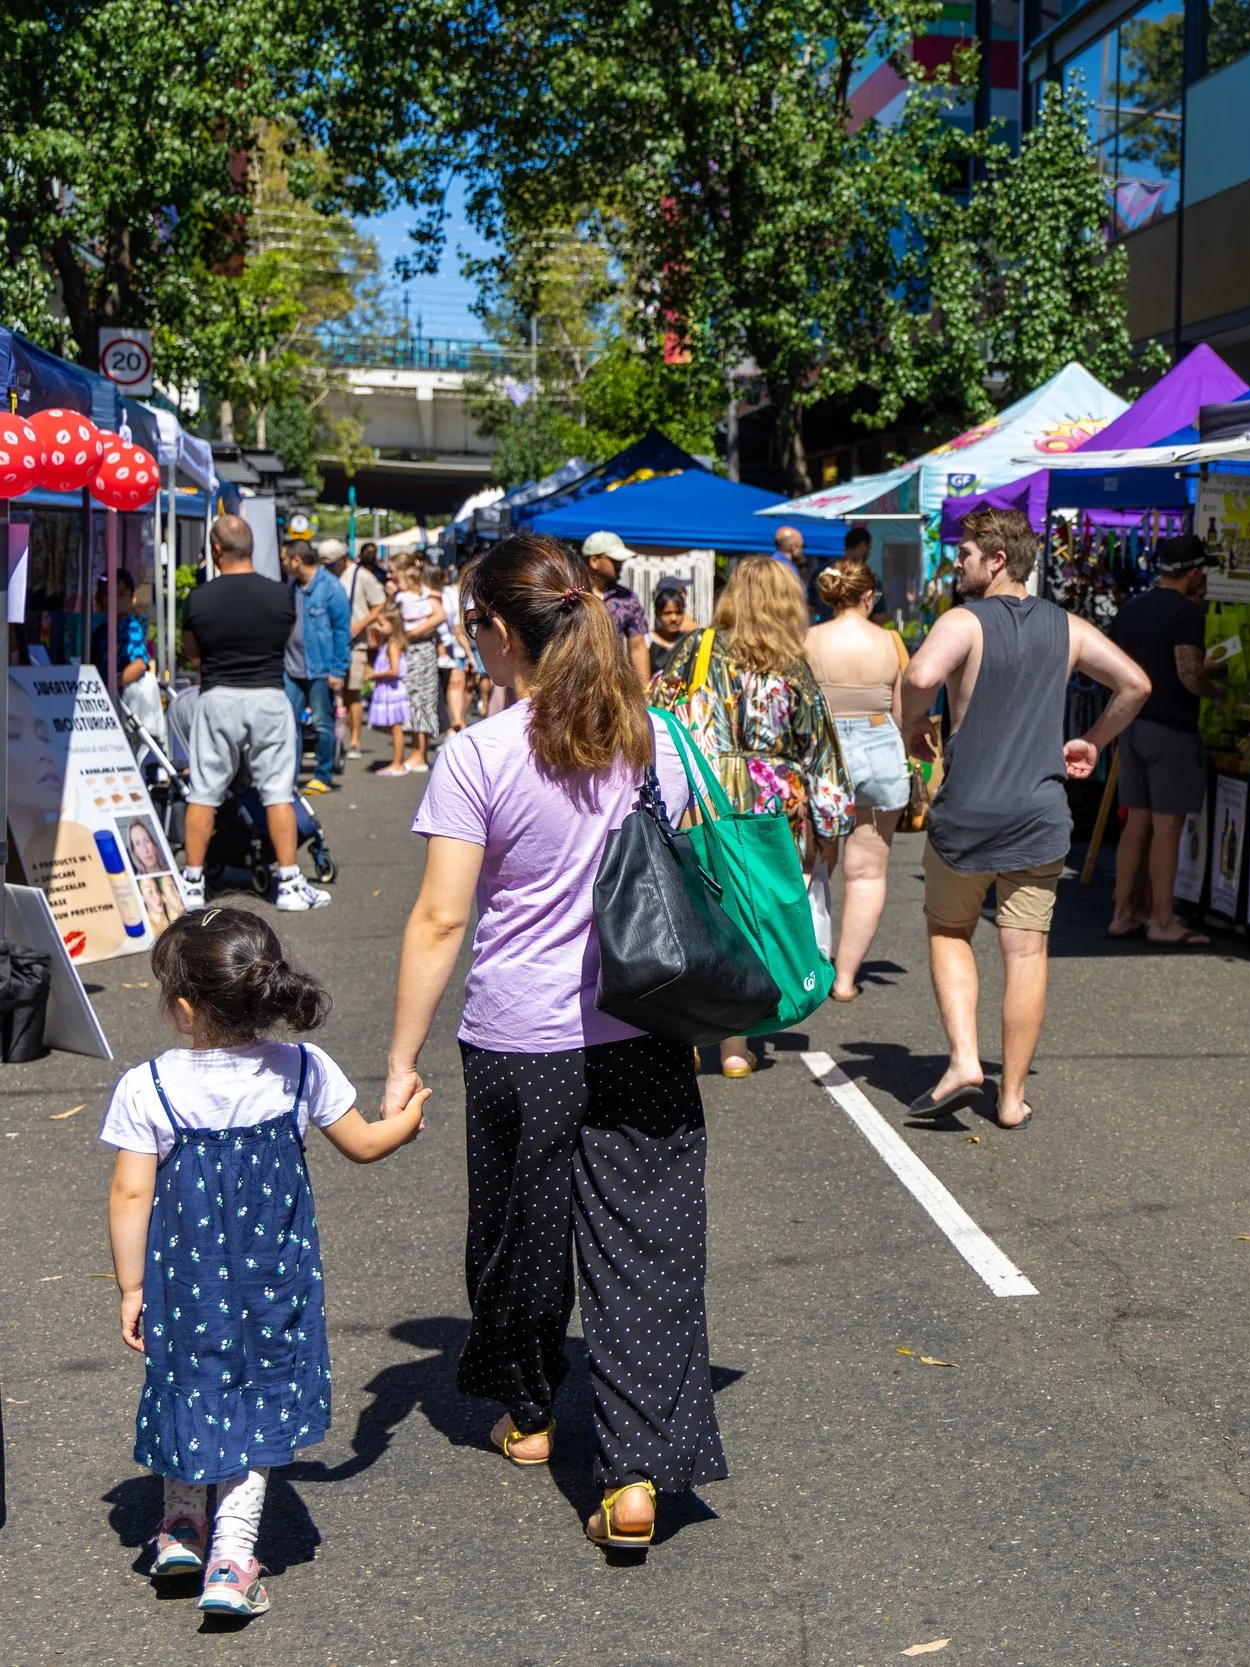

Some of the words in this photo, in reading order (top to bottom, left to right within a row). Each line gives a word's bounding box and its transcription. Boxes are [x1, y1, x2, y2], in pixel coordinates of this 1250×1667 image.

[112, 351, 142, 372] 20
[950, 474, 971, 487] GF
[33, 681, 102, 696] SWEATPROOF
[76, 699, 110, 713] TINTED
[53, 716, 118, 733] MOISTURISER
[39, 857, 77, 868] PRODUCTS
[41, 870, 76, 882] SKINCARE
[46, 882, 87, 894] CONCEALER
[71, 904, 114, 916] PROTECTION
